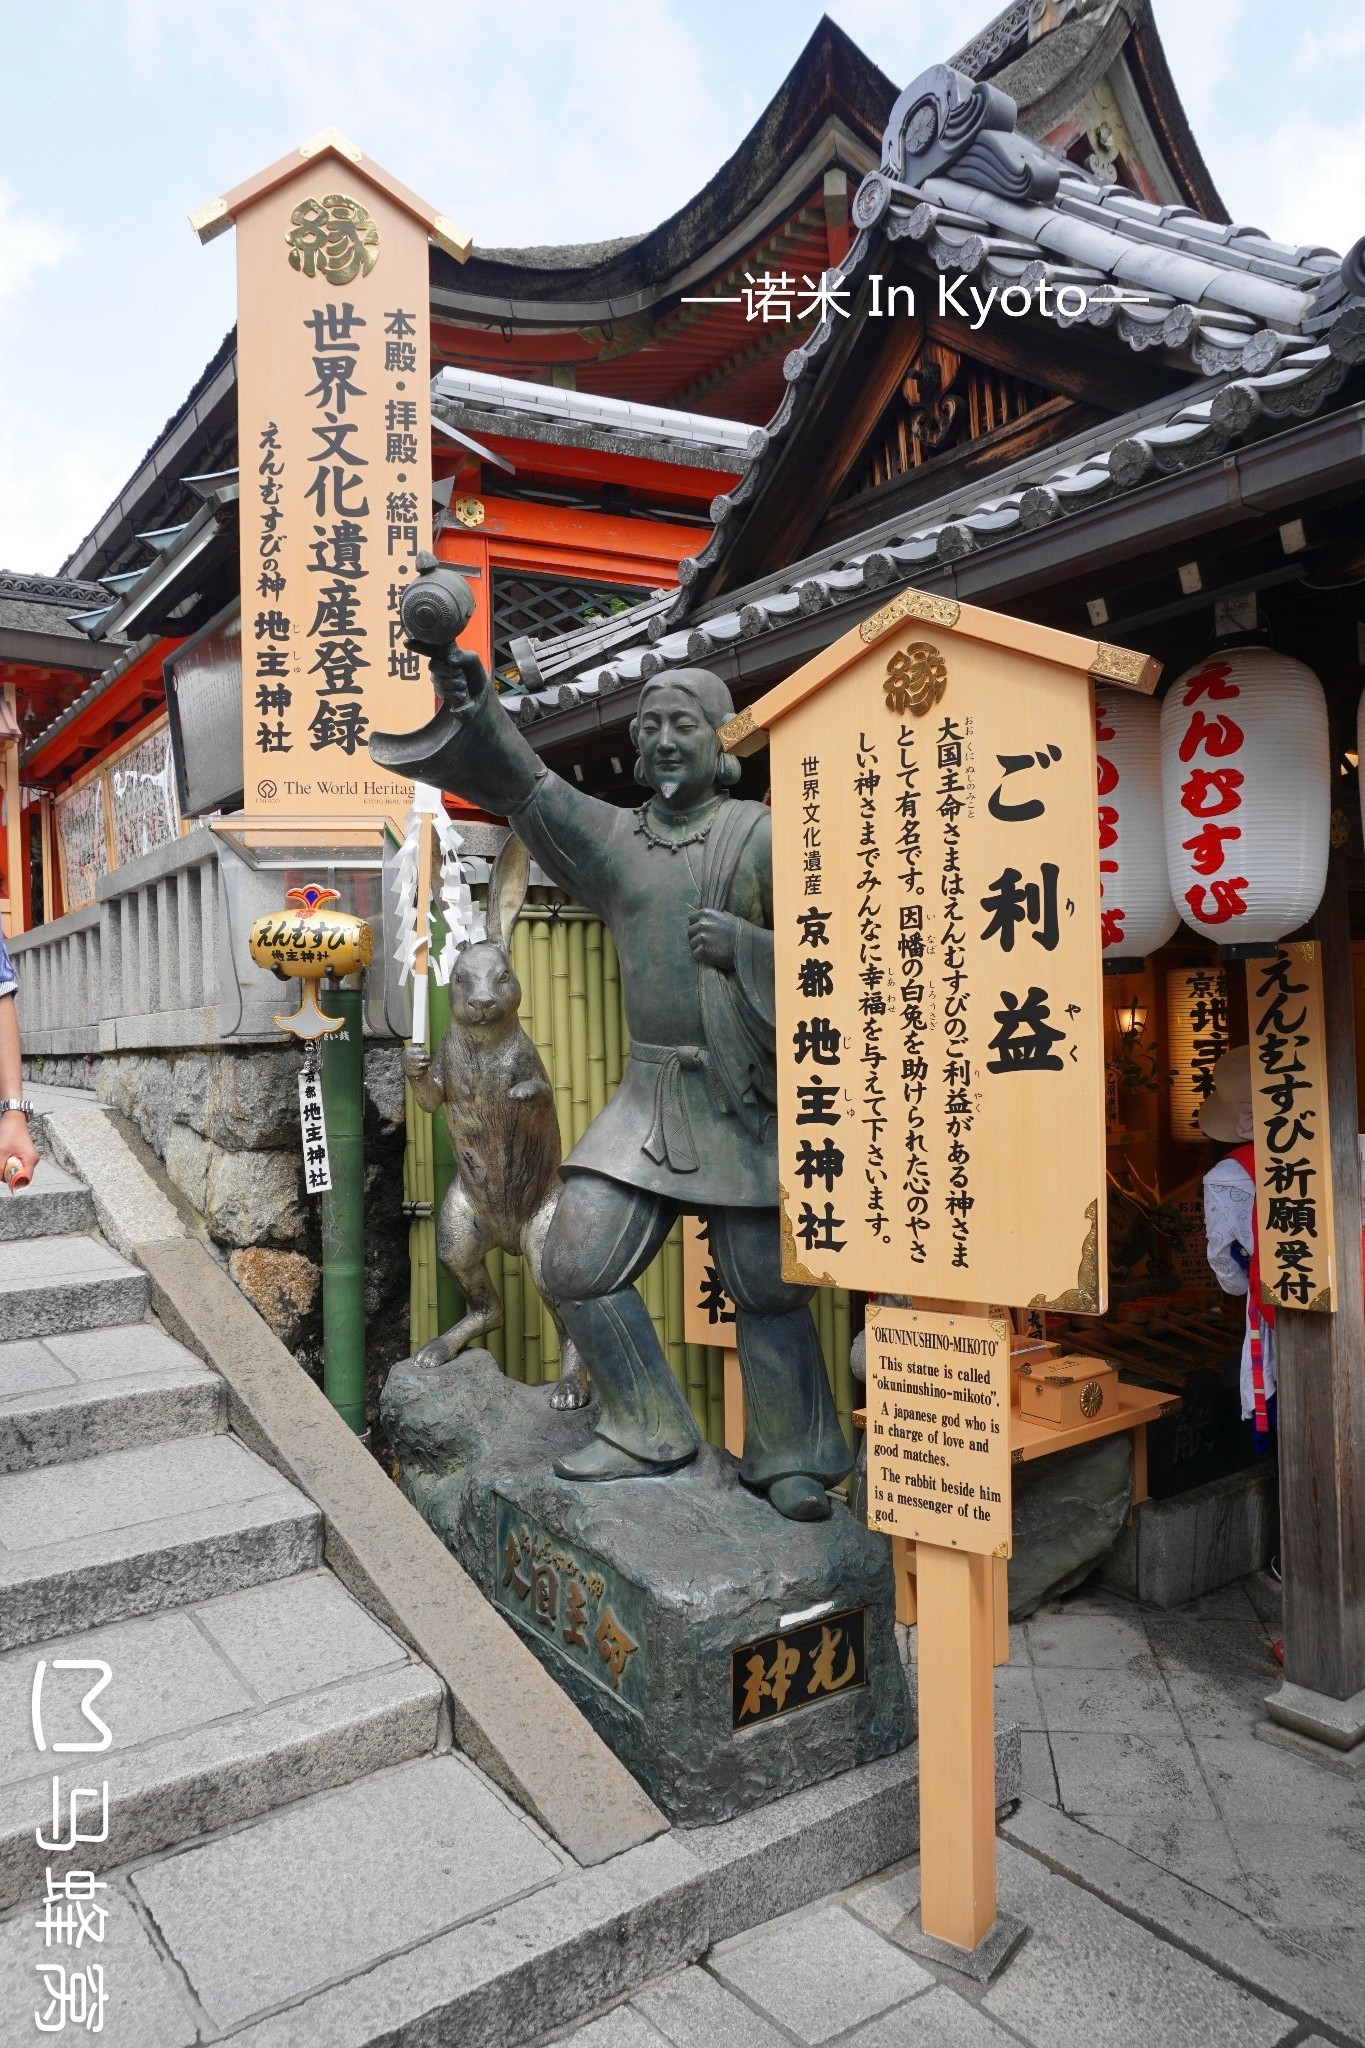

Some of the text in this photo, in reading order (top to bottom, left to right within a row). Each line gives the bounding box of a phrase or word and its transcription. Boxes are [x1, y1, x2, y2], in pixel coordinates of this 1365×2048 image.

[303, 302, 372, 756] 世界文化遺産登録
[284, 781, 415, 798] The World Heritag
[1179, 661, 1250, 924] えんむすび
[980, 744, 1067, 1075] ご利益
[257, 919, 350, 951] えんむすび
[271, 949, 331, 963] 地主神社
[1255, 950, 1319, 1306] えんむすび祈願受付
[879, 1356, 991, 1385] This statue is called
[881, 1404, 1000, 1434] A japanese god who is
[874, 1421, 989, 1453] in charge of love and
[874, 1443, 949, 1467] good matches.
[881, 1467, 1001, 1503] The rabbit beside him
[875, 1486, 991, 1521] is a messenger of the
[875, 1509, 898, 1525] god.
